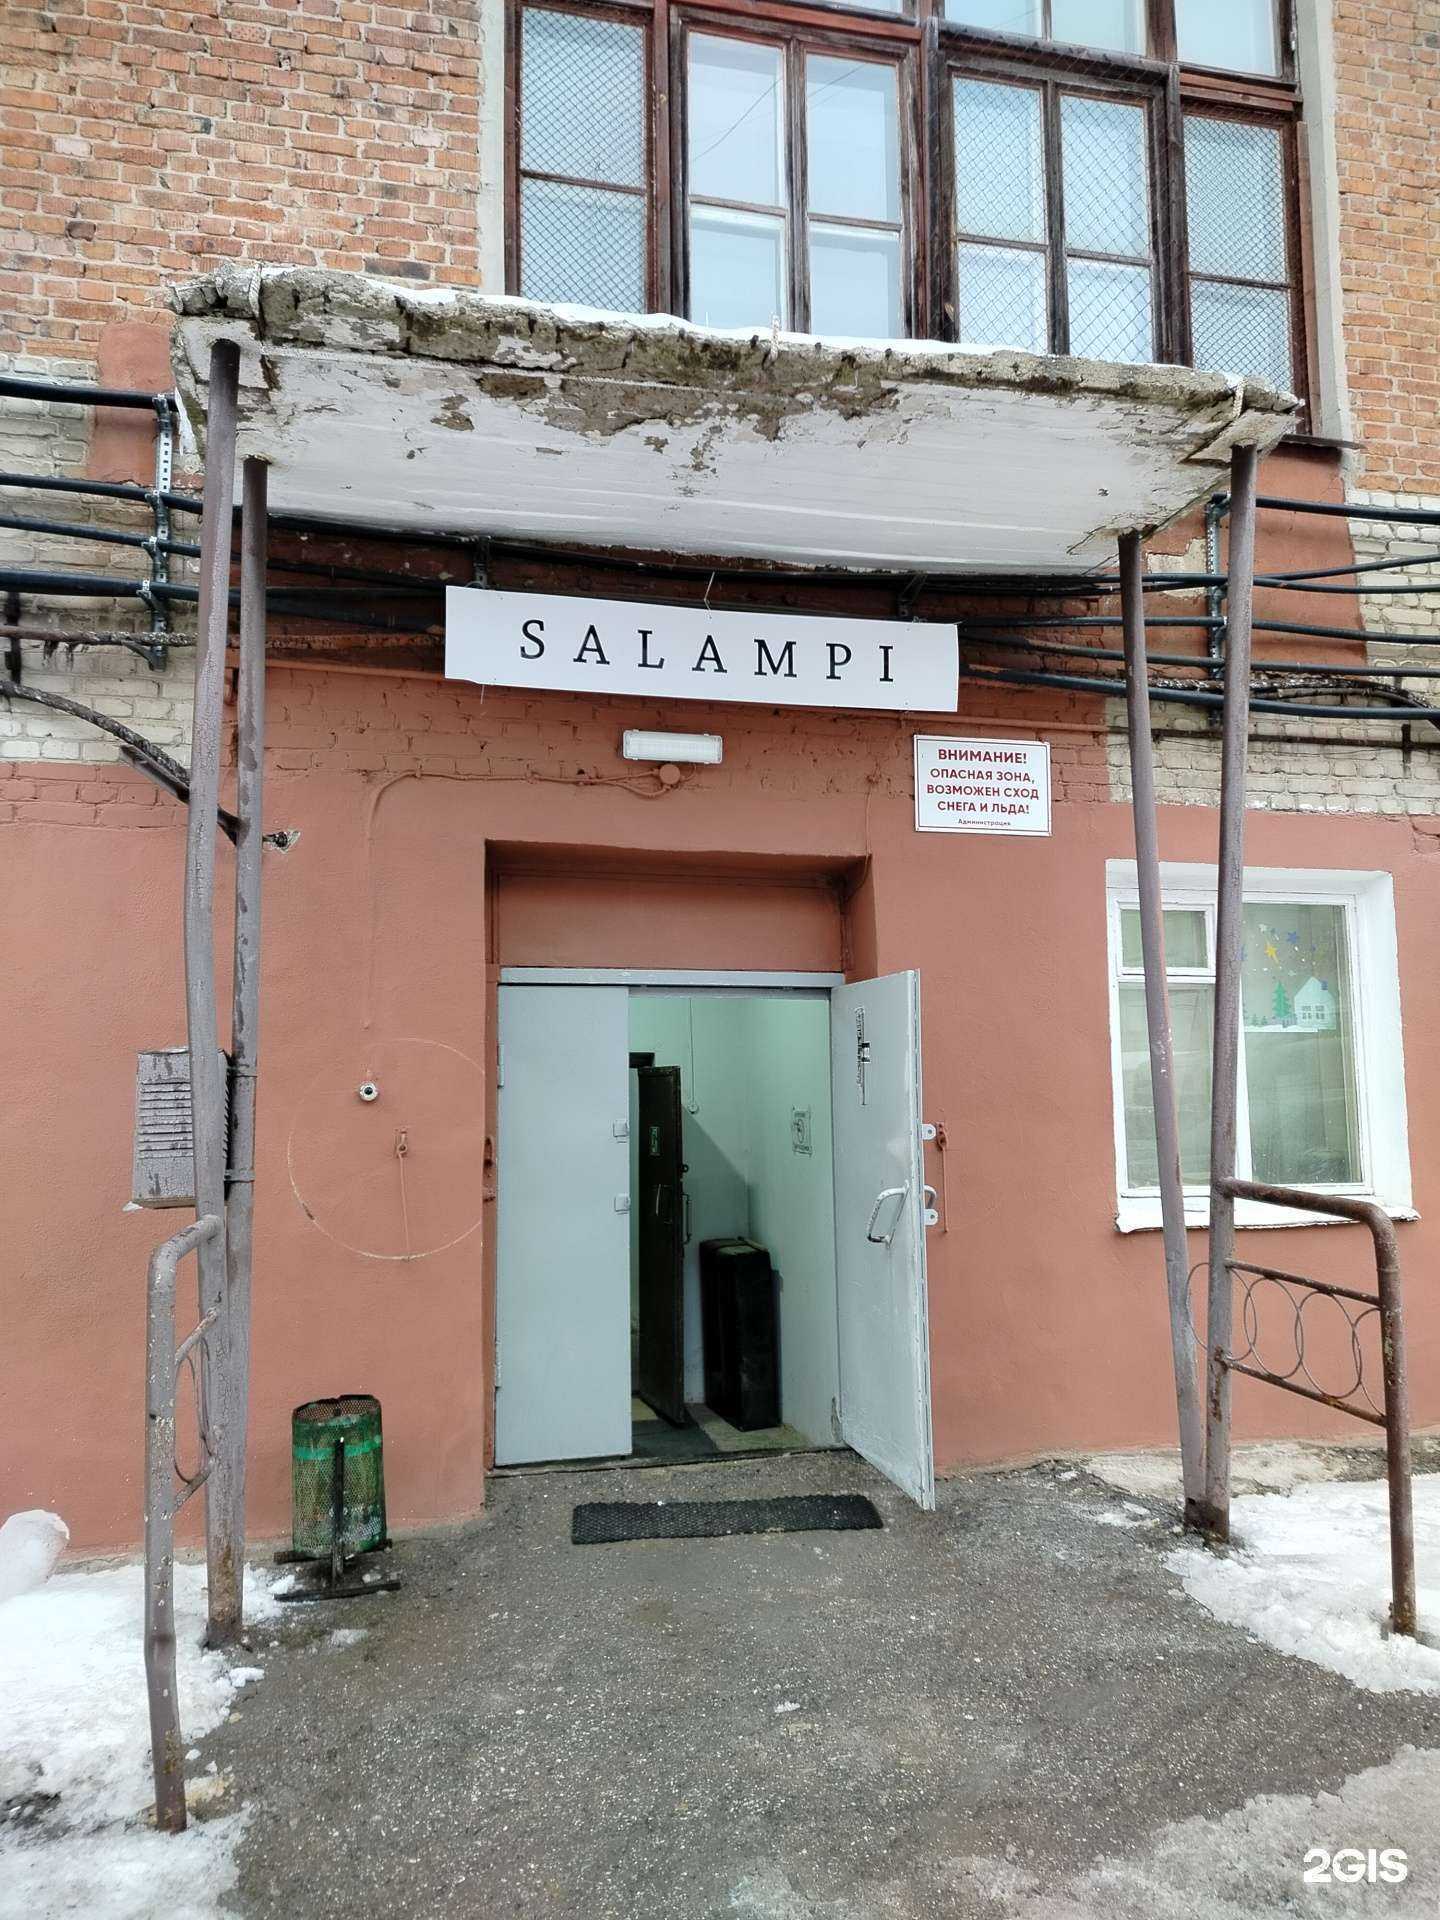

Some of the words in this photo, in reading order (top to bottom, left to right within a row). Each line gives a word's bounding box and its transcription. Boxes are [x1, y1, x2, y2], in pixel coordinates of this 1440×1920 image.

[520, 619, 894, 683] SALAMPI
[938, 748, 1027, 764] ВНИМАНИЕ!
[930, 768, 993, 781] ОПАСНАЯ
[997, 771, 1035, 784] ЗОНА,
[926, 783, 1000, 797] ВОЗМОЖЕН
[1003, 787, 1039, 800] СХОД
[937, 800, 977, 813] СНЕГА
[980, 803, 988, 813] И
[991, 803, 1030, 815] ЛЬДА!
[958, 818, 1011, 827] Администрация
